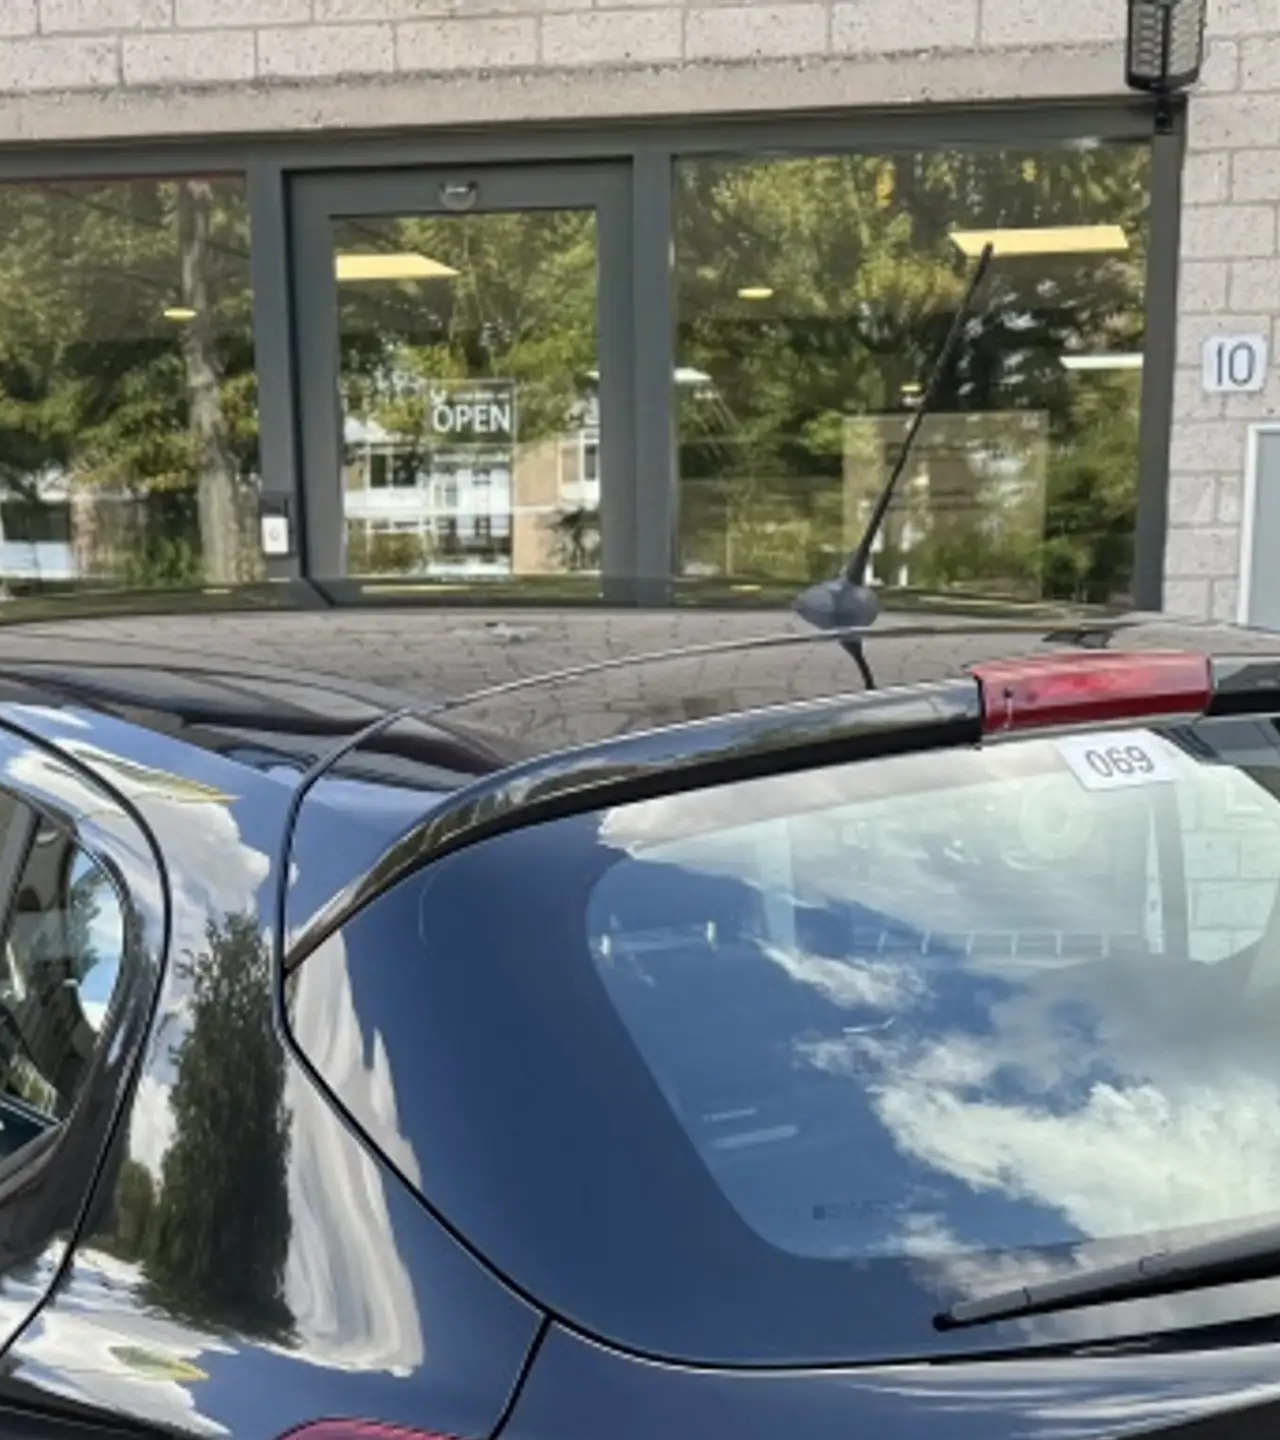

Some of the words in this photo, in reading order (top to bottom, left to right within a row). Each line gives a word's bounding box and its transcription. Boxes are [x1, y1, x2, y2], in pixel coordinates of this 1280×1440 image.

[1216, 341, 1257, 388] 10
[432, 403, 510, 433] OPEN
[1085, 745, 1155, 778] 069
